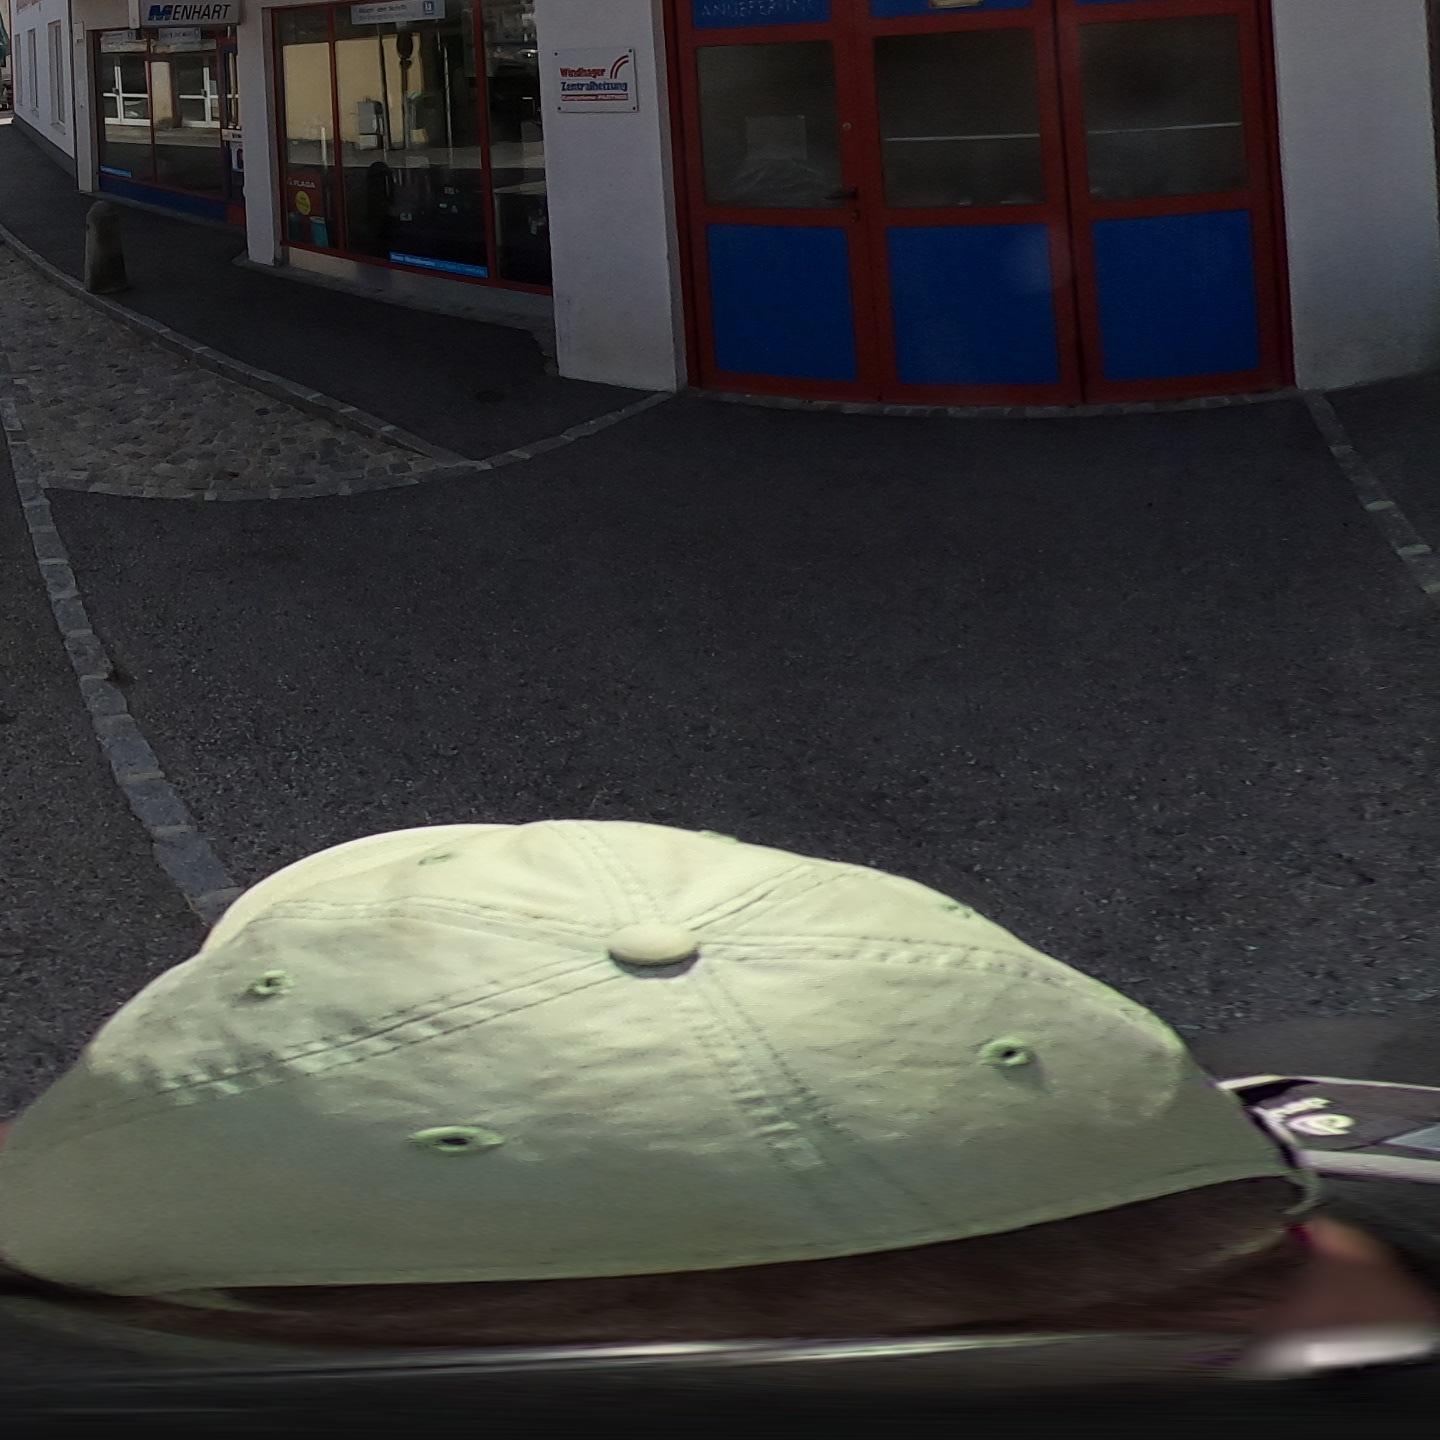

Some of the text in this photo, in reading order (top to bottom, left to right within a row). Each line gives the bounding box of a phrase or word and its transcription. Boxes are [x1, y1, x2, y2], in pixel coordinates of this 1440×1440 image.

[148, 4, 231, 21] MENHART
[560, 67, 606, 79] Windhager
[561, 81, 628, 92] Zentralheizung
